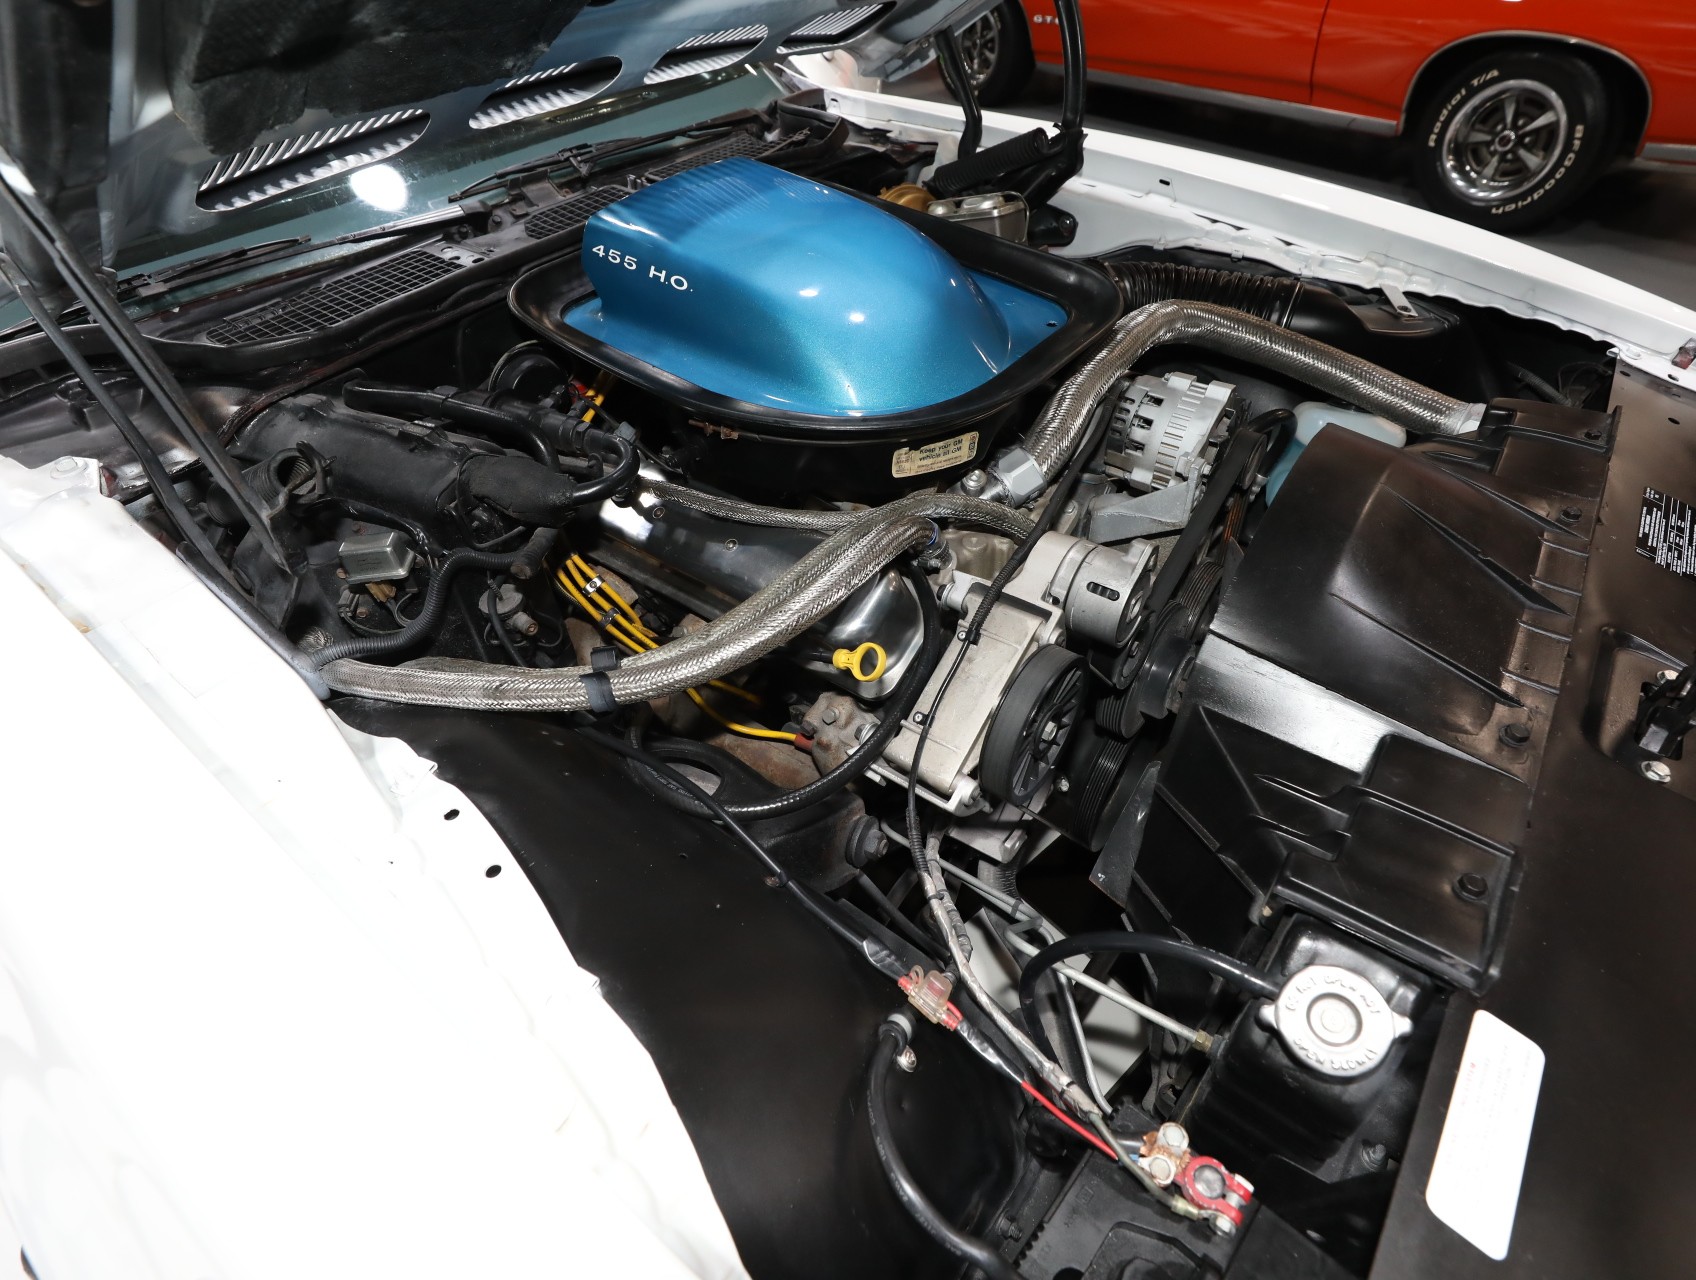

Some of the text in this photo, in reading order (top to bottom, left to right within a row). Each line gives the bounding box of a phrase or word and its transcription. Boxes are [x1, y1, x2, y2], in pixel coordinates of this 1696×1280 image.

[1428, 68, 1500, 148] Radial T/A
[1491, 124, 1585, 215] BFGoodrich
[592, 244, 694, 293] 455 H.O.
[918, 452, 941, 462] vehicle
[951, 446, 962, 454] GM
[938, 442, 951, 452] your
[952, 438, 963, 446] GM
